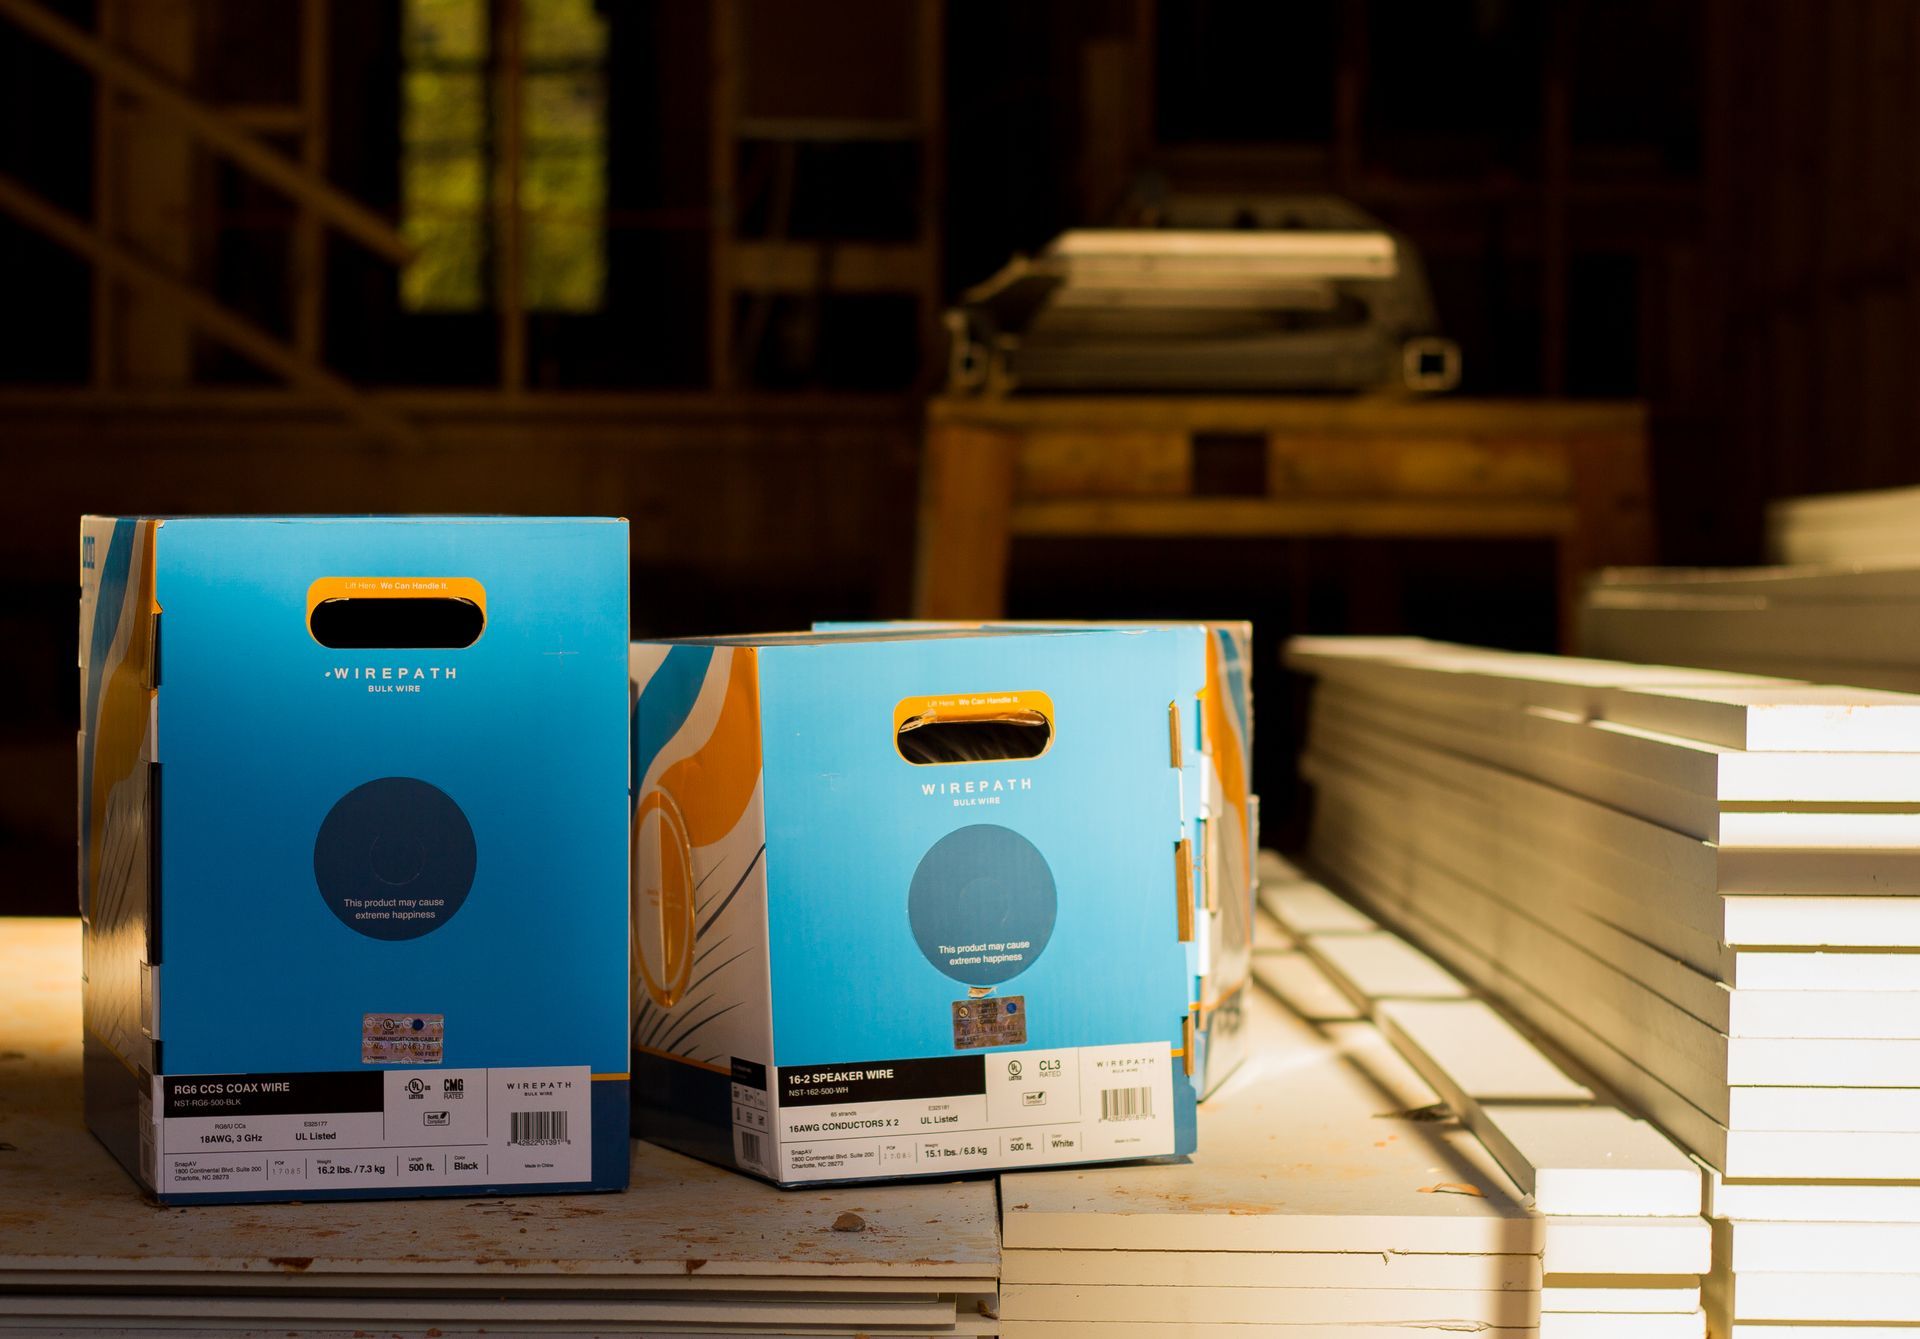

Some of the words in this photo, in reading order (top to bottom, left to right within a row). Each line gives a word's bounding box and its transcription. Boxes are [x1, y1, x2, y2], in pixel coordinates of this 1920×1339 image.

[334, 668, 457, 679] WIREPATH
[922, 778, 1032, 796] WIREPATH
[953, 798, 976, 806] BULK
[978, 796, 1000, 805] WIRE
[344, 898, 362, 908] This
[364, 898, 396, 909] product
[398, 899, 416, 908] may
[356, 912, 390, 920] extreme
[392, 910, 436, 920] happiness
[938, 945, 956, 954] This
[957, 944, 986, 954] product
[988, 942, 1005, 952] may
[1006, 940, 1030, 950] cause
[949, 956, 982, 966] extreme
[982, 954, 1023, 964] happiness
[1040, 1060, 1060, 1070] CL3
[1097, 1058, 1154, 1067] WIREPATH
[788, 1074, 811, 1084] 16-2
[812, 1071, 864, 1083] SPEAKER
[866, 1069, 894, 1080] WIRE
[174, 1085, 197, 1095] RG6
[200, 1084, 224, 1094] CCS
[226, 1084, 258, 1094] COAX
[261, 1082, 290, 1092] WIRE
[444, 1078, 464, 1092] CMG
[507, 1082, 572, 1090] WIREPATH
[788, 1086, 849, 1096] NST-162-500-WH
[174, 1098, 241, 1107] NST-RG6-500-BLK
[920, 1116, 932, 1125] UL
[934, 1115, 958, 1124] Listed
[790, 1124, 820, 1134] 16AWG
[822, 1120, 884, 1131] CONDUCTORS
[886, 1119, 892, 1127] X
[894, 1118, 899, 1127] 2
[200, 1135, 234, 1144] 18AWG,
[236, 1134, 242, 1143] 3
[245, 1134, 262, 1142] GHz
[296, 1132, 307, 1141] UL
[310, 1132, 336, 1140] Listed
[1010, 1144, 1024, 1152] 500
[1026, 1142, 1034, 1150] ft.
[1051, 1139, 1074, 1148] White
[925, 1150, 942, 1158] 15.1
[944, 1148, 958, 1156] lbs.
[964, 1147, 976, 1155] 6.8
[977, 1146, 988, 1156] kg
[317, 1166, 335, 1174] 16.2
[337, 1166, 352, 1174] lbs.
[360, 1165, 372, 1173] 7.3
[374, 1164, 385, 1174] kg
[408, 1164, 424, 1172] 500
[426, 1163, 435, 1172] ft.
[454, 1162, 478, 1170] Black
